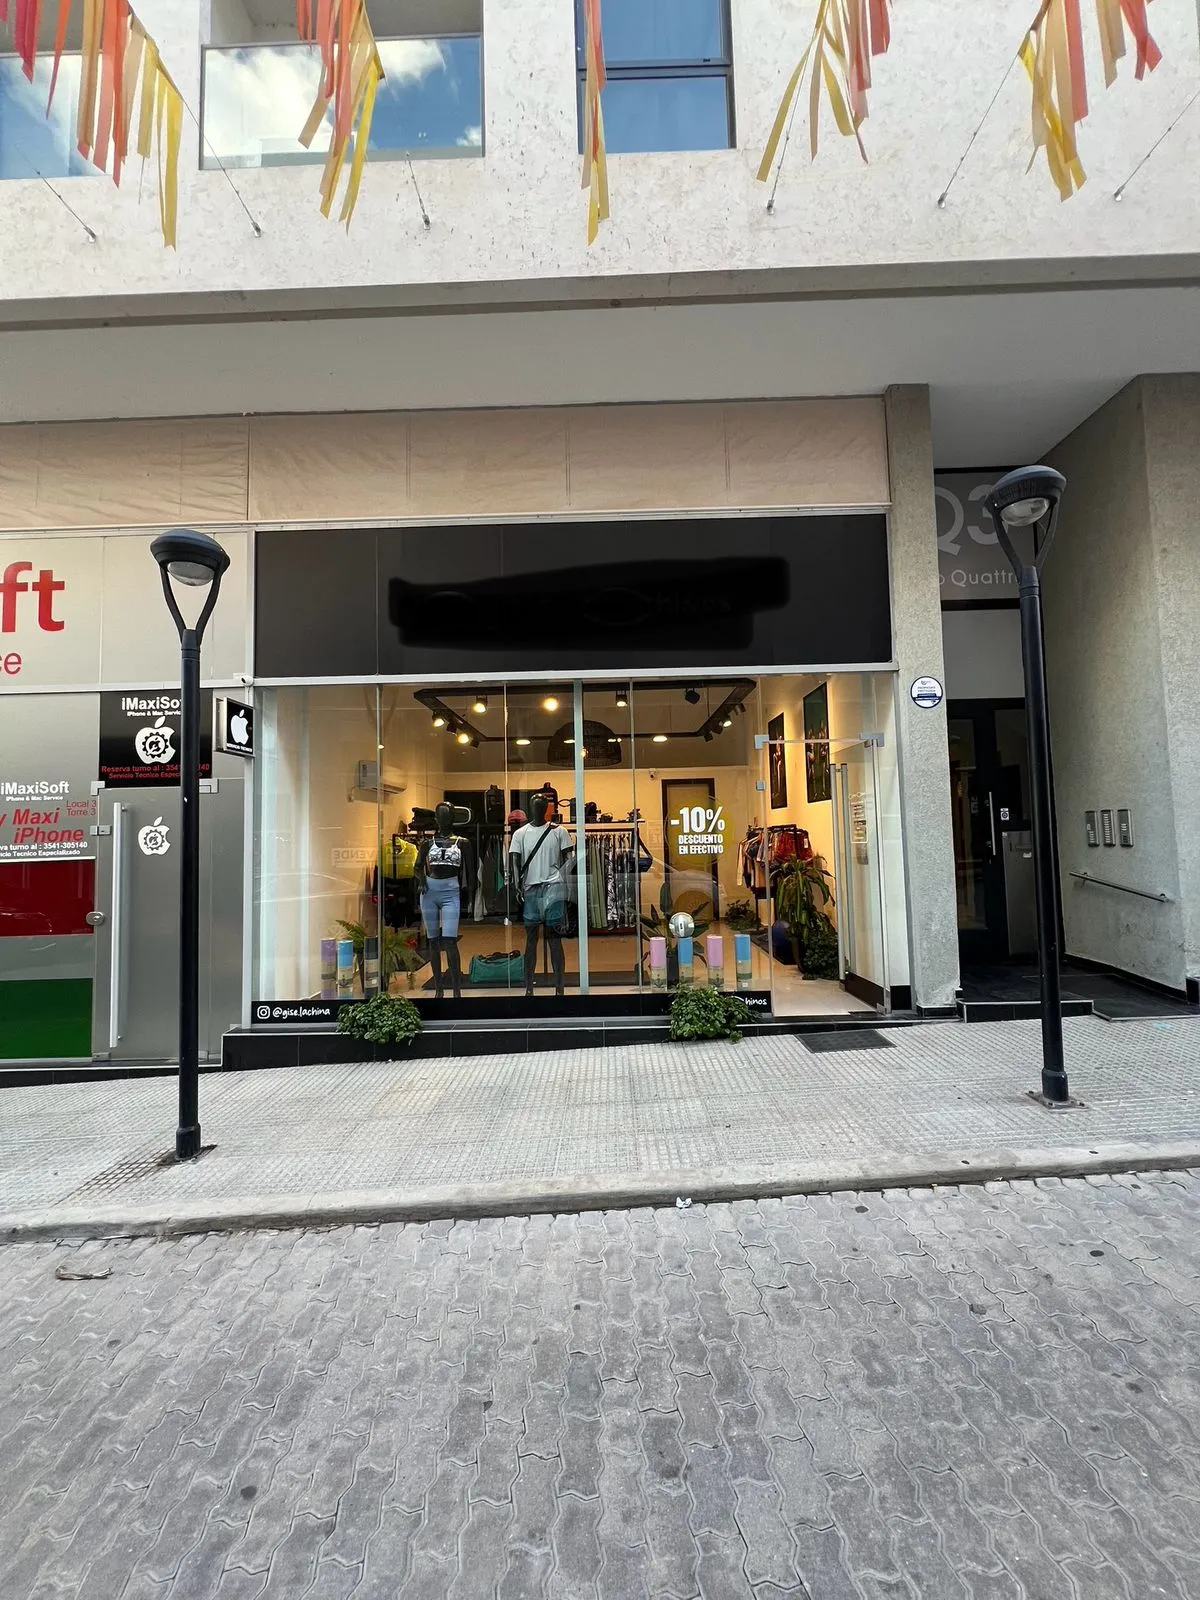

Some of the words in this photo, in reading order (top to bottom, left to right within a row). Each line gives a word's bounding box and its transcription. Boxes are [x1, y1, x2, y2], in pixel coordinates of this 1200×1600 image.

[121, 696, 181, 711] iMaxiSo
[1, 780, 69, 795] iMaxiSoft
[66, 800, 89, 808] Local
[91, 800, 96, 808] 3
[12, 807, 60, 825] Maxi
[66, 808, 88, 816] Torre
[91, 808, 96, 816] 3
[670, 806, 726, 833] -10%
[14, 826, 84, 844] iPhone
[678, 834, 724, 845] DESCUENTO
[679, 845, 689, 855] EN
[689, 844, 724, 854] EFECTIVO
[272, 1006, 331, 1019] @gise.lachina
